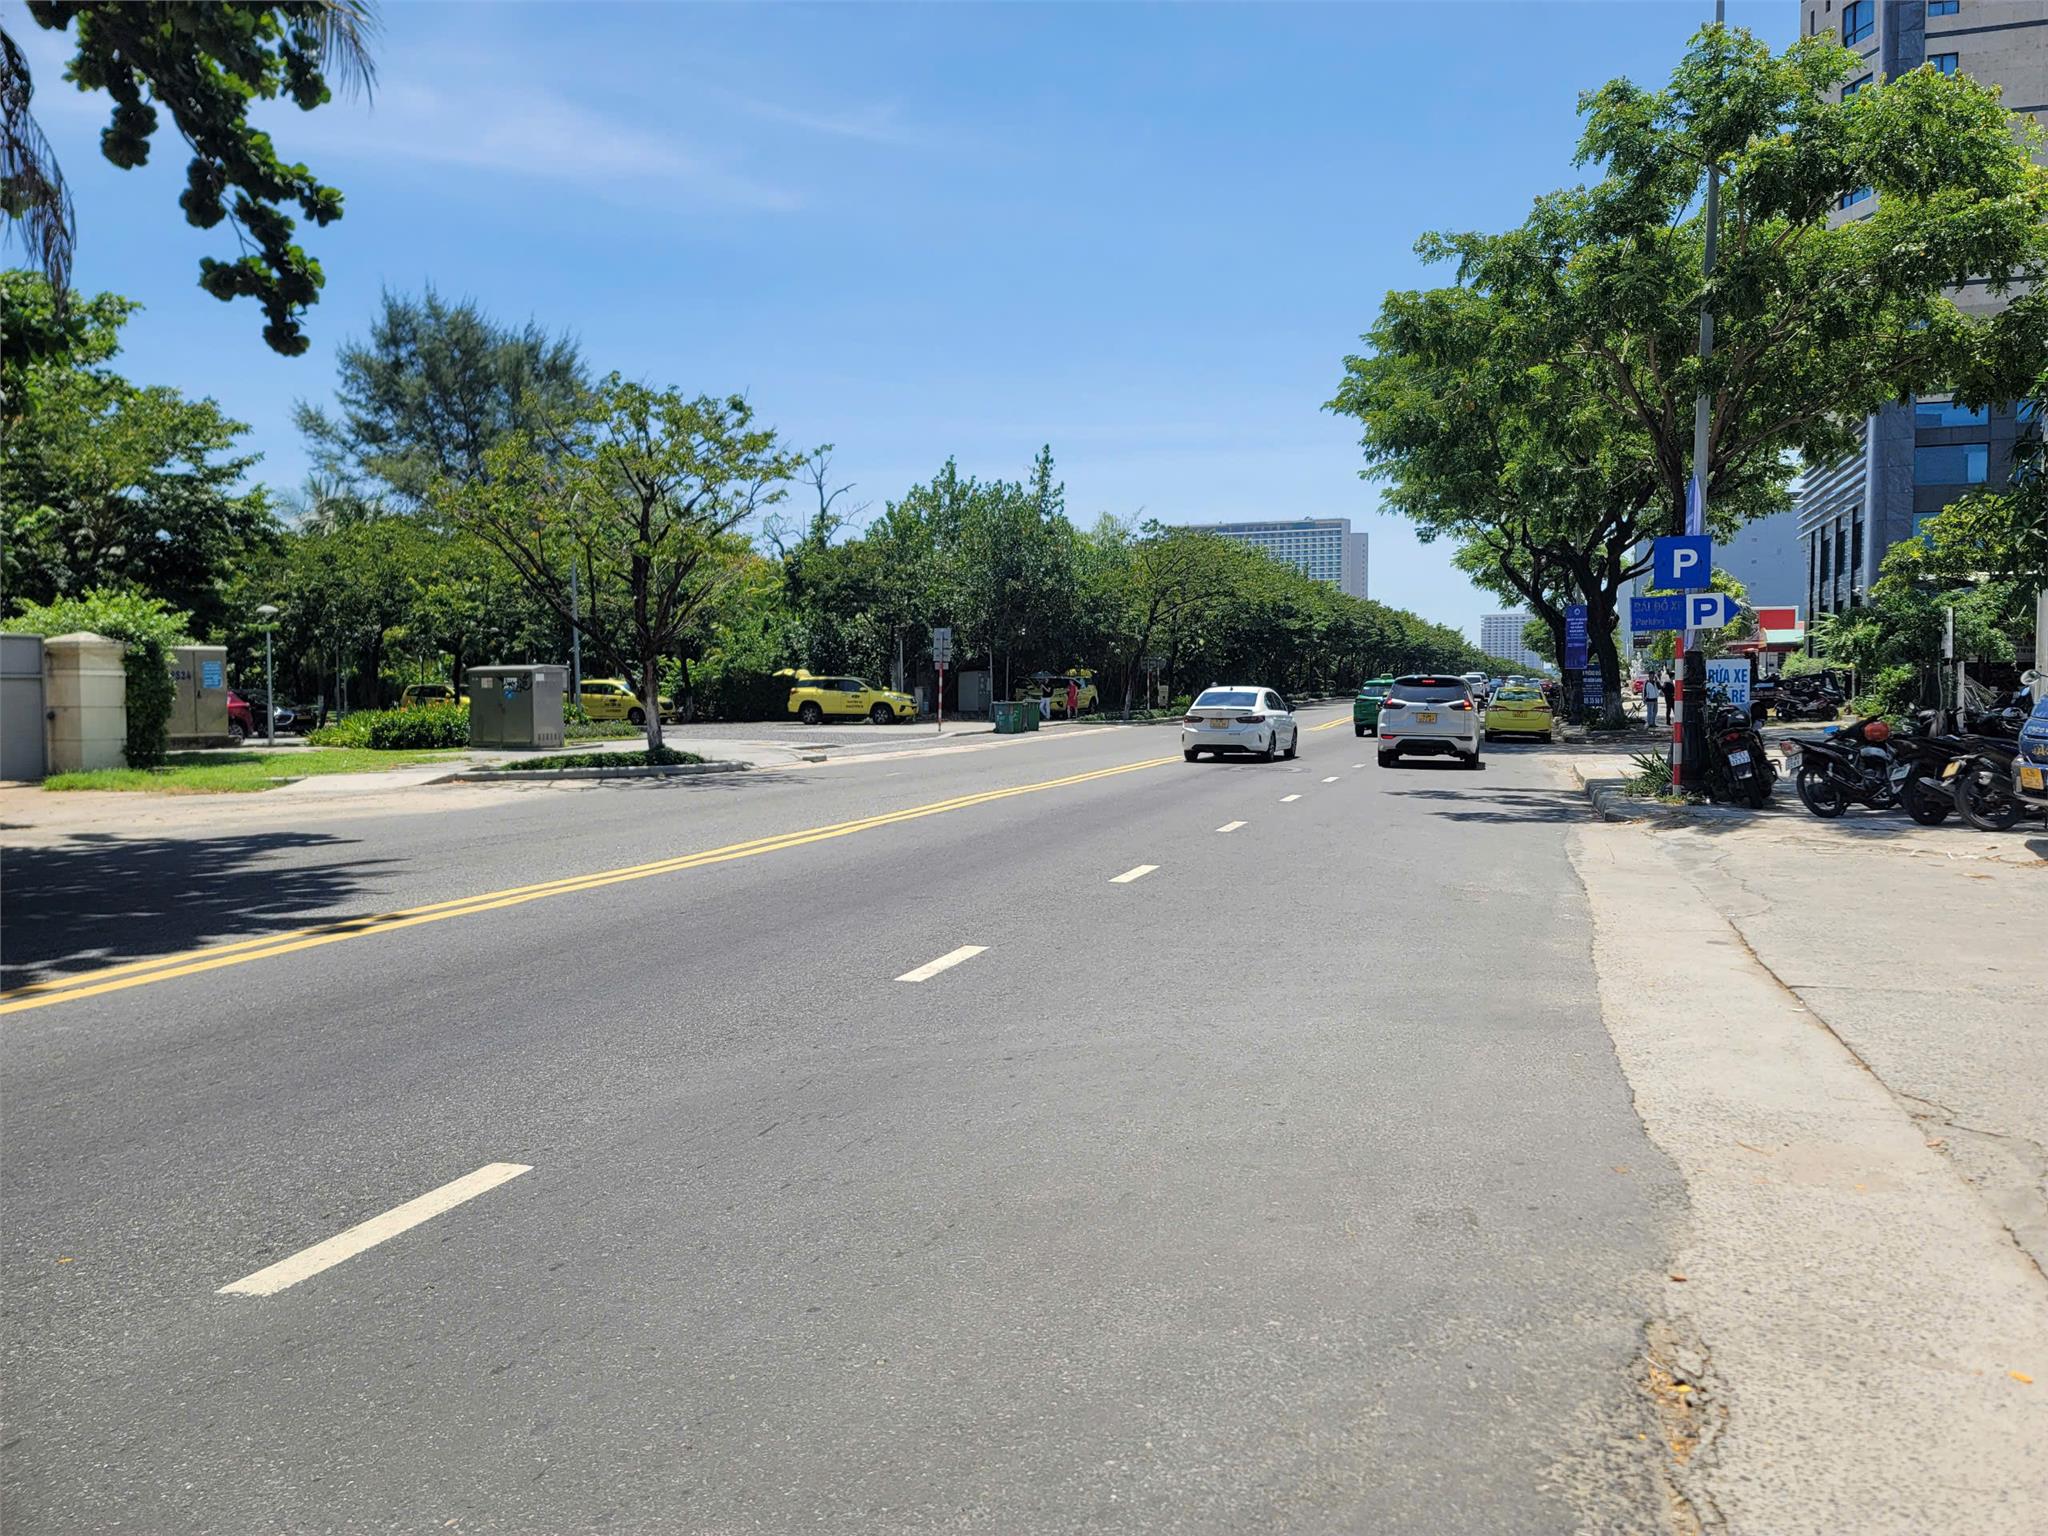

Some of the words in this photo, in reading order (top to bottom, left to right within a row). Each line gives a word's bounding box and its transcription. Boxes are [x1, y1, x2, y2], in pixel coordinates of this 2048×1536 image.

[1673, 548, 1699, 579] P
[1693, 598, 1719, 626] P
[1734, 668, 1748, 683] XE
